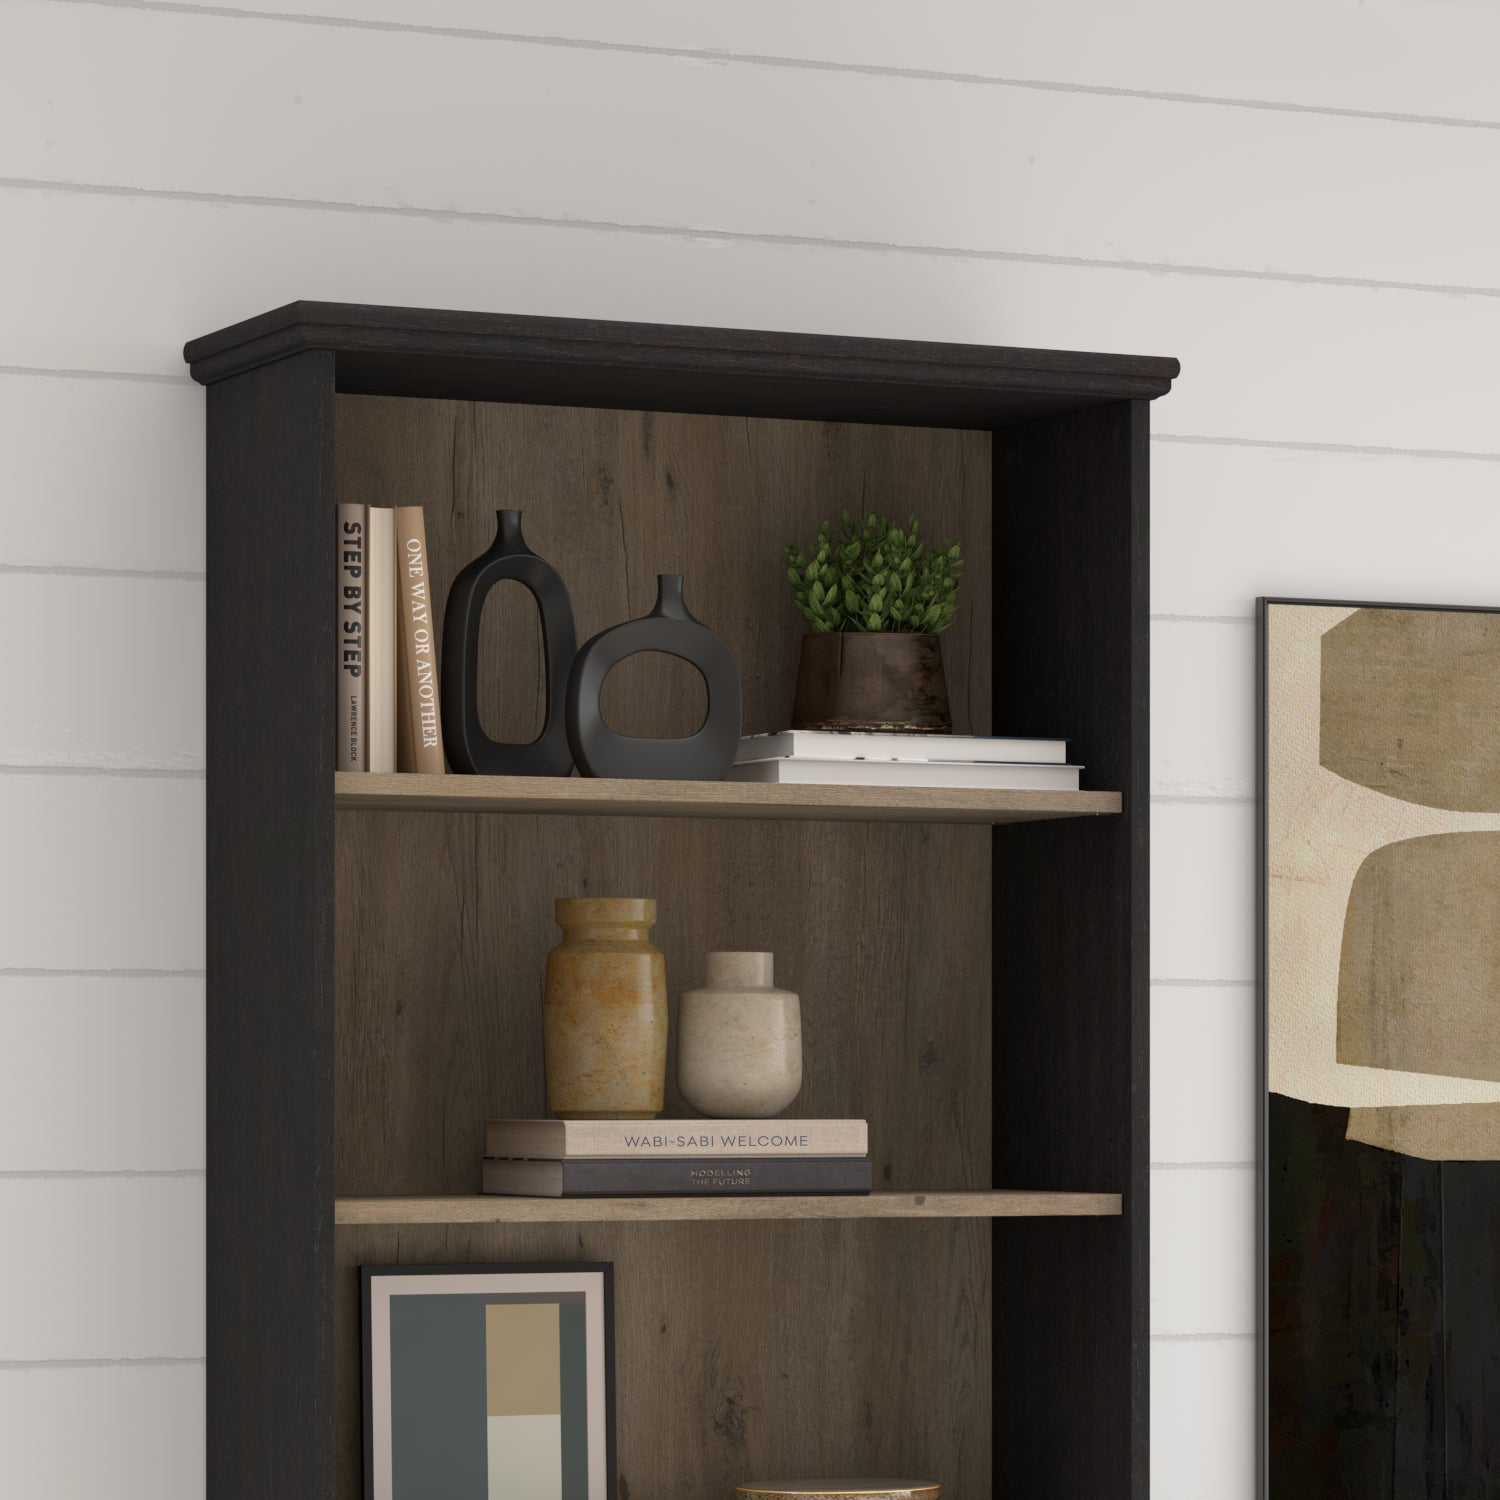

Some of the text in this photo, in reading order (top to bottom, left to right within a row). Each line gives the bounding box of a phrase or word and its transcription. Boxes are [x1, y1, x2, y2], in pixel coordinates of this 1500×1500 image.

[343, 521, 361, 677] STEP BY STEP
[406, 538, 438, 749] ONE WAY OR ANOTHER
[350, 695, 358, 763] LAWRENCE BLOCK
[624, 1135, 809, 1148] WABI-SABI WELCOME
[690, 1168, 752, 1177] MODELLING
[691, 1177, 751, 1186] THE FUTURE
